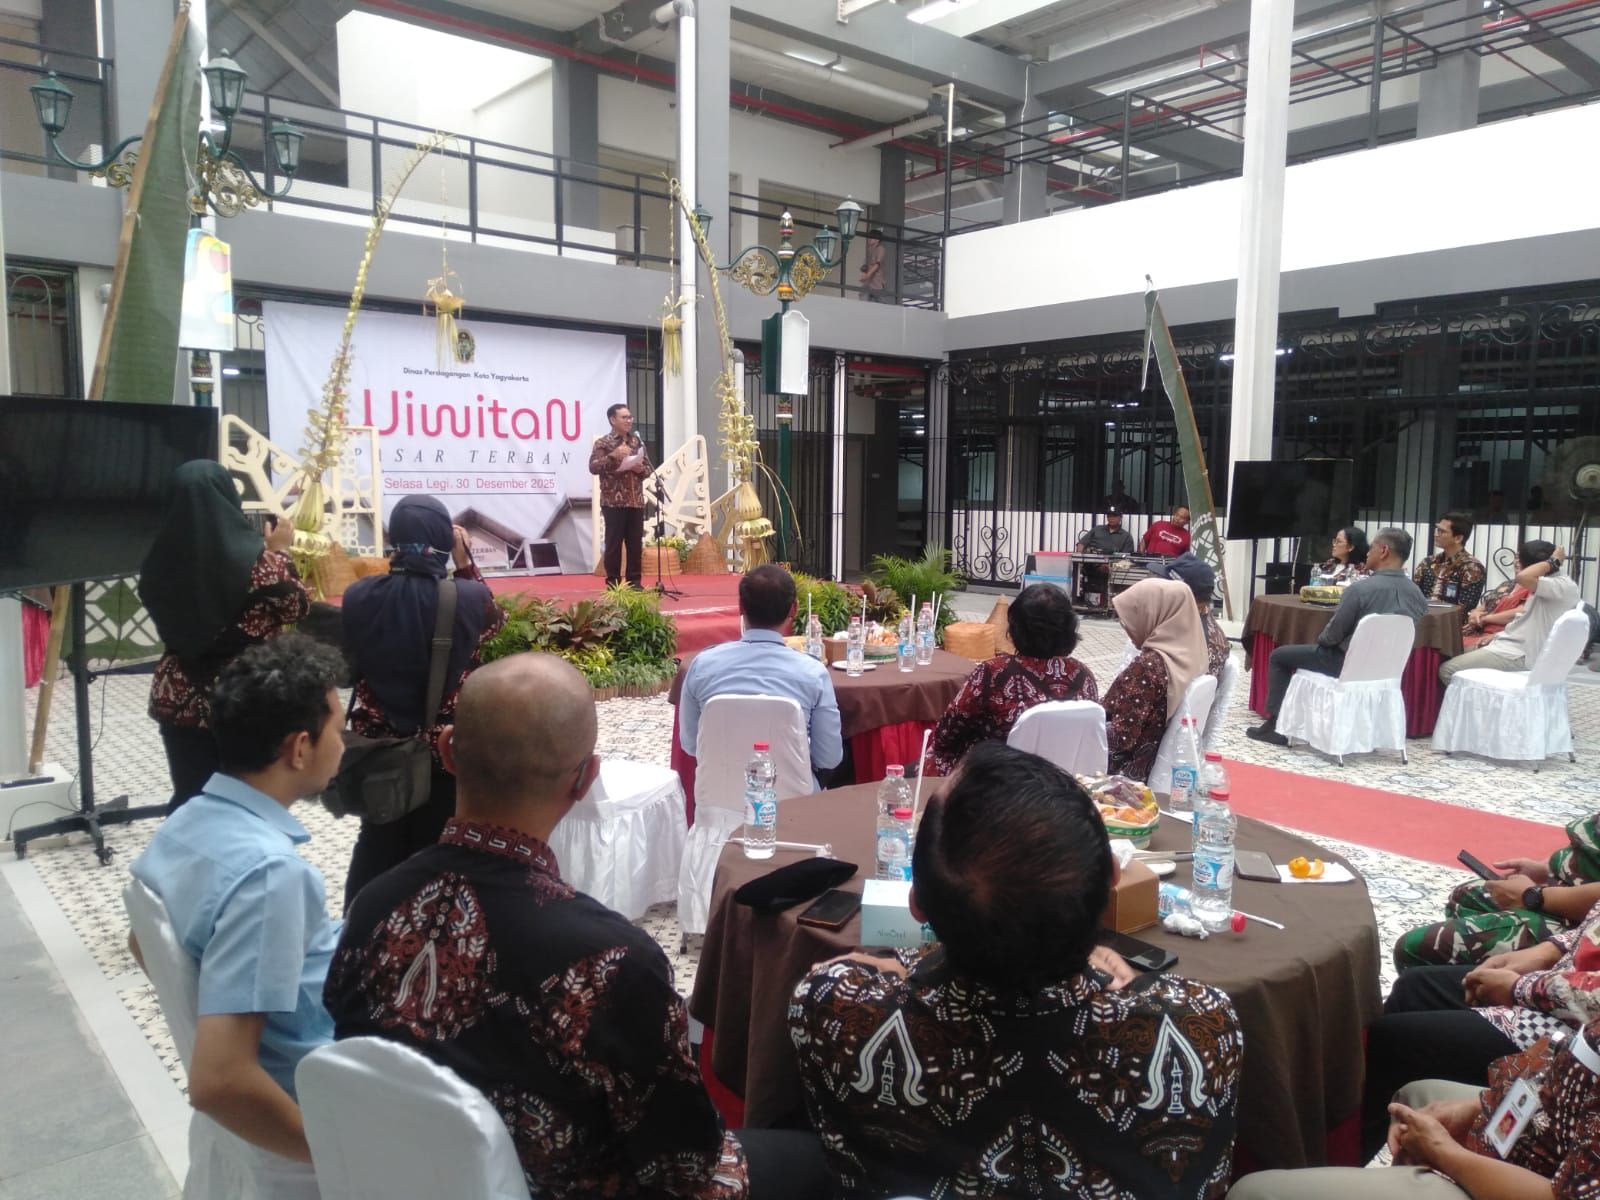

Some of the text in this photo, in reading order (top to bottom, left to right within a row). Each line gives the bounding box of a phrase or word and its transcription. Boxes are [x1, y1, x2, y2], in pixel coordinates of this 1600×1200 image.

[403, 367, 423, 375] Dinas
[424, 368, 471, 379] Perdagangan
[473, 371, 490, 379] Kota
[470, 450, 571, 465] TERBAN
[384, 477, 423, 489] Selasa
[456, 478, 470, 489] 30
[476, 478, 528, 489] Desember
[531, 478, 556, 489] 2025
